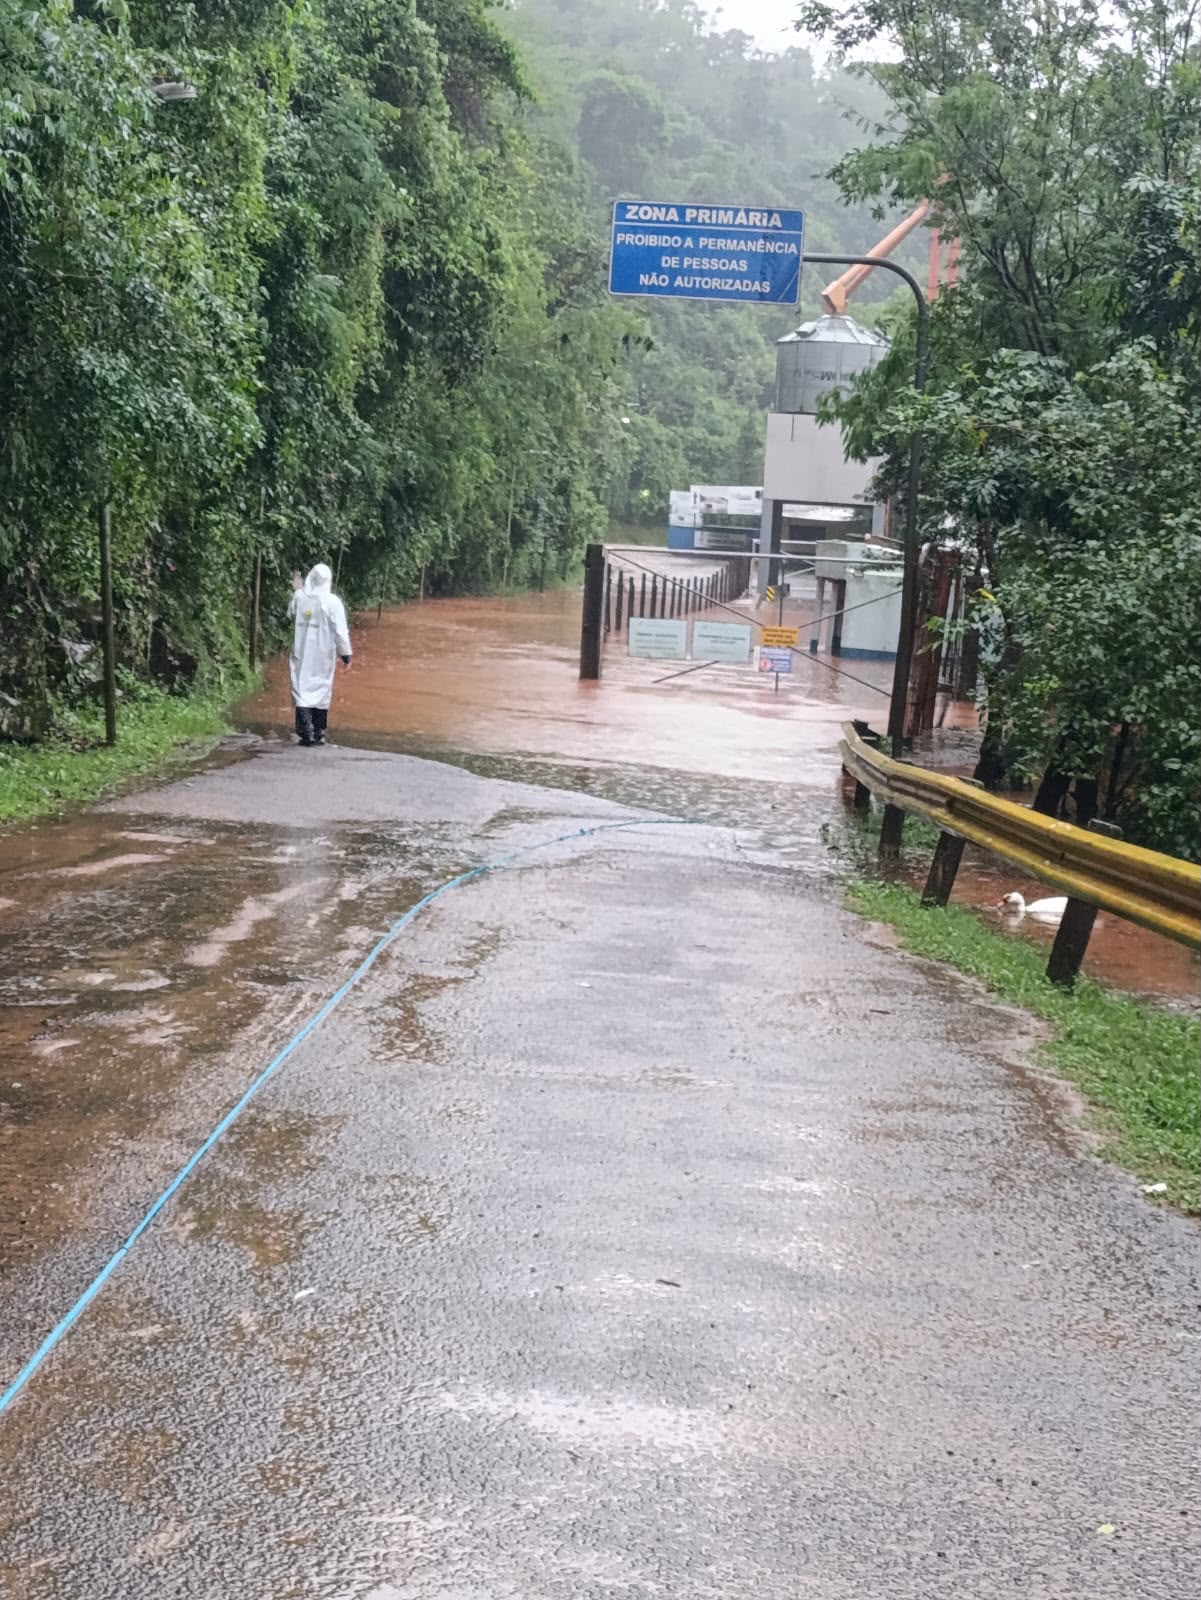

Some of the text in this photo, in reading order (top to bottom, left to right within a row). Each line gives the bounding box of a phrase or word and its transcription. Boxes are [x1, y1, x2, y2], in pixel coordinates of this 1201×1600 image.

[625, 205, 783, 228] ZONA PRIMÁRIA
[616, 233, 798, 254] PROIBIDO A PERMANÊNCIA
[661, 256, 748, 271] DE PESSOAS
[639, 272, 771, 293] NÃO AUTORIZADAS
